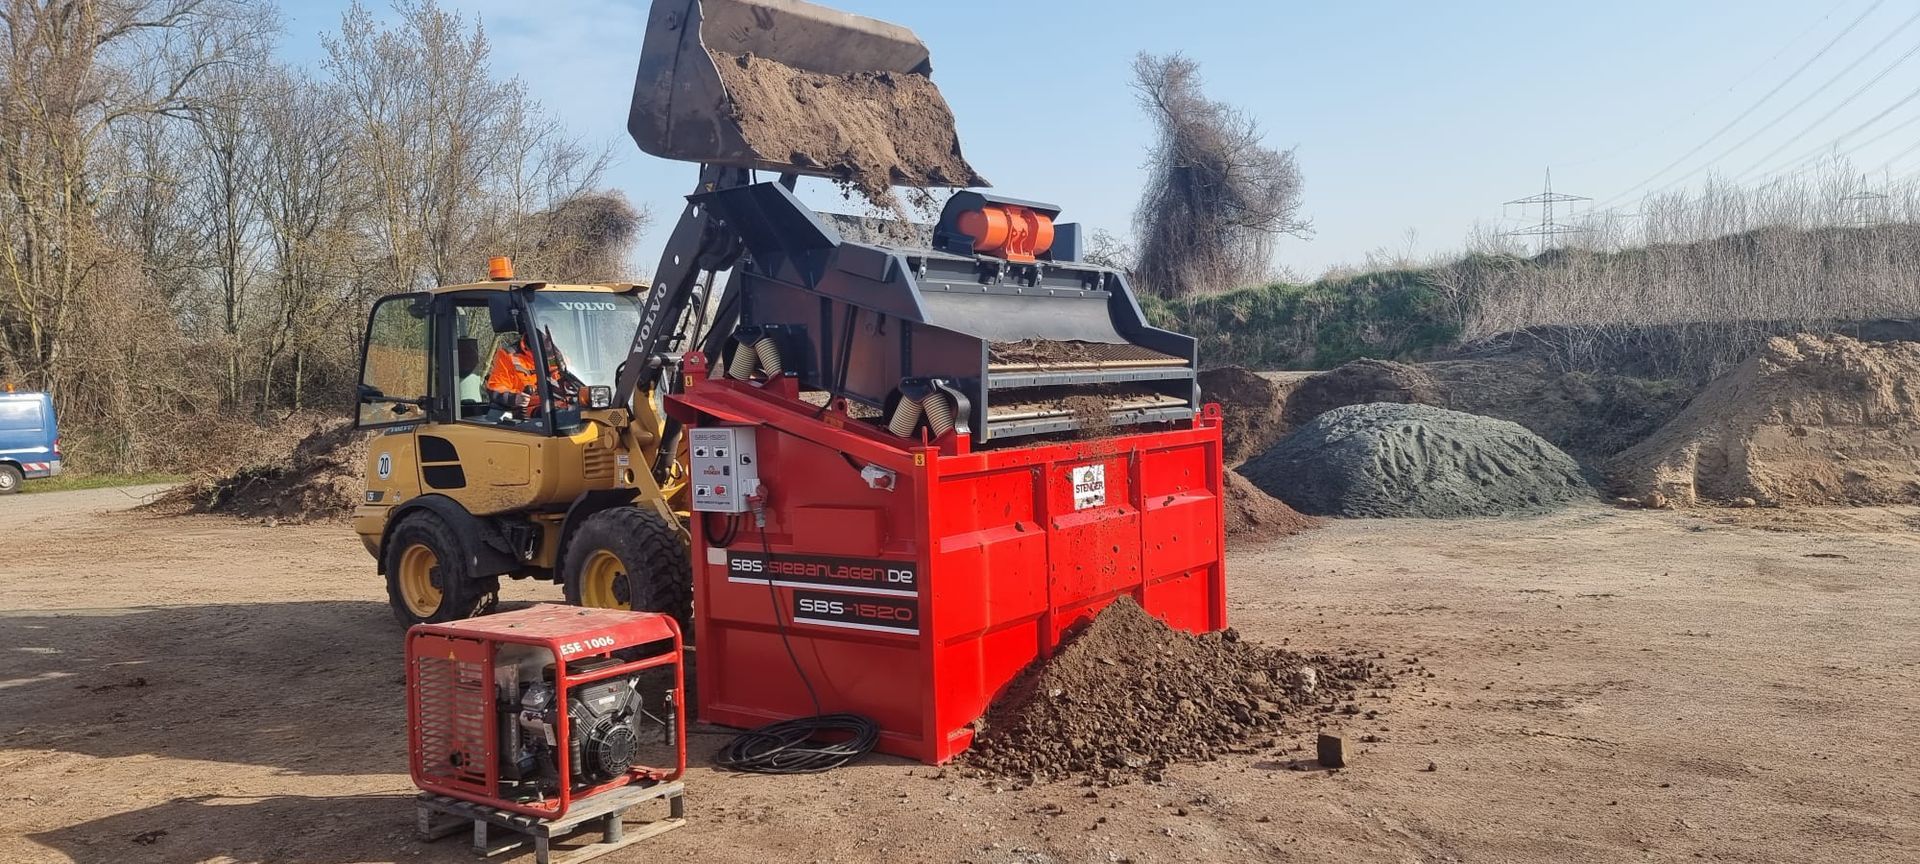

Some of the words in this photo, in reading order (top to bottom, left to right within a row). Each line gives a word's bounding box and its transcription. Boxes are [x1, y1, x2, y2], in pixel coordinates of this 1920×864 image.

[559, 301, 616, 311] VOLVO
[634, 282, 667, 354] VOLVO
[380, 457, 389, 475] 20
[799, 598, 913, 622] SBS-1520
[560, 641, 583, 655] ESE
[583, 636, 615, 649] 1006
